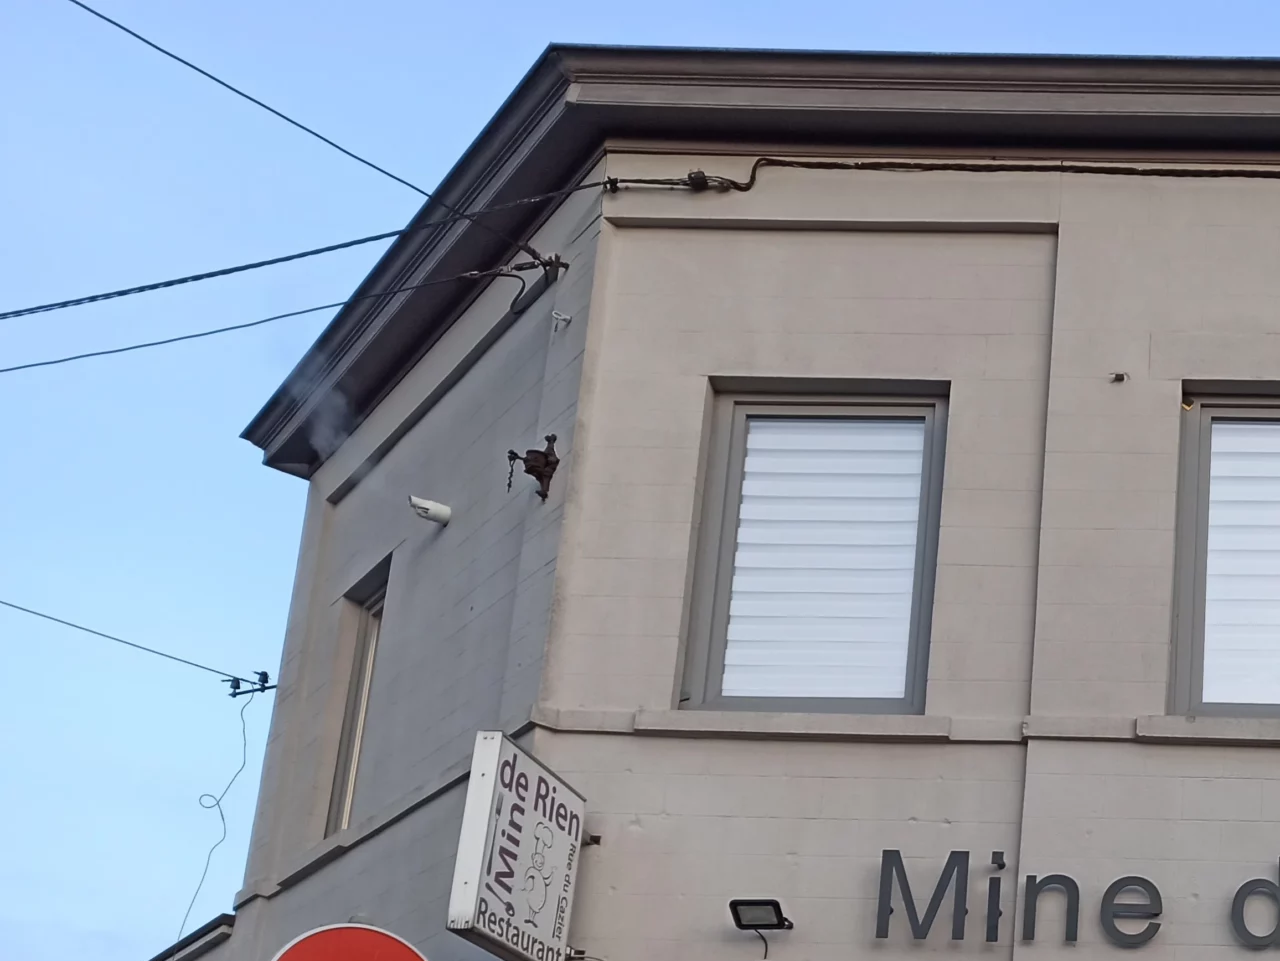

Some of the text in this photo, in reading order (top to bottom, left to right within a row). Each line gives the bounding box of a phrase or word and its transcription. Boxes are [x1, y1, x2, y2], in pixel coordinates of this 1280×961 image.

[499, 753, 581, 842] de Rien
[556, 842, 578, 942] Rue du Cazier
[875, 849, 1164, 949] Mine
